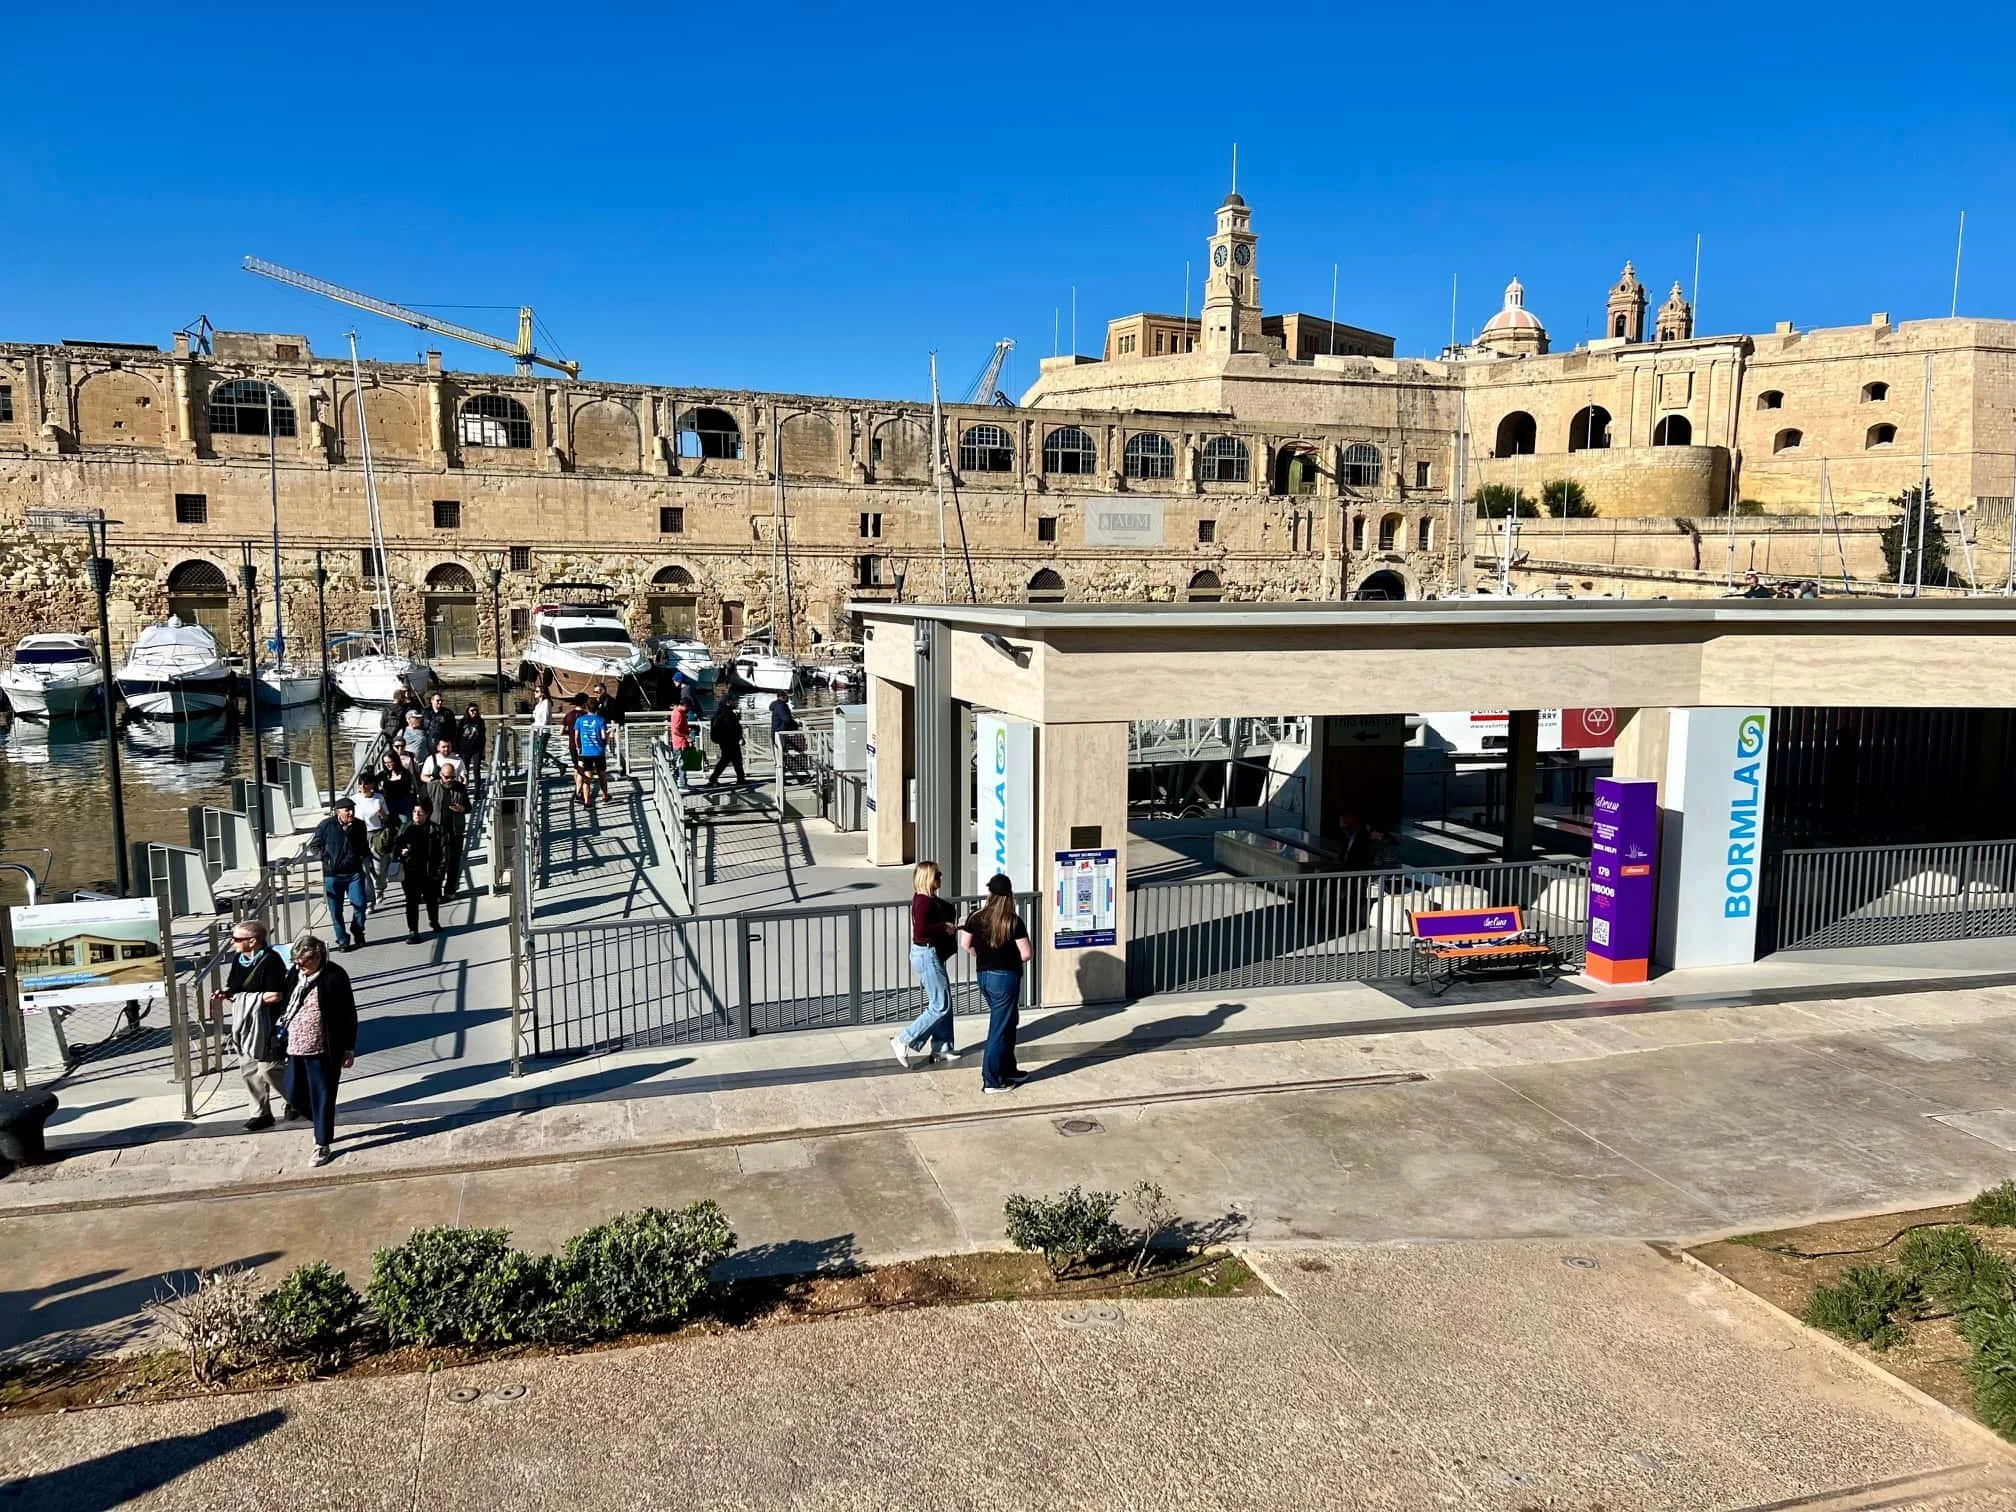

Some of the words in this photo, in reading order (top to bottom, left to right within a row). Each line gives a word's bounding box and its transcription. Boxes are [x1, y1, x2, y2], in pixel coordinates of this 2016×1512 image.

[1538, 712, 1557, 720] ERRY
[995, 781, 1006, 876] MLA
[1725, 762, 1760, 918] BORMLA
